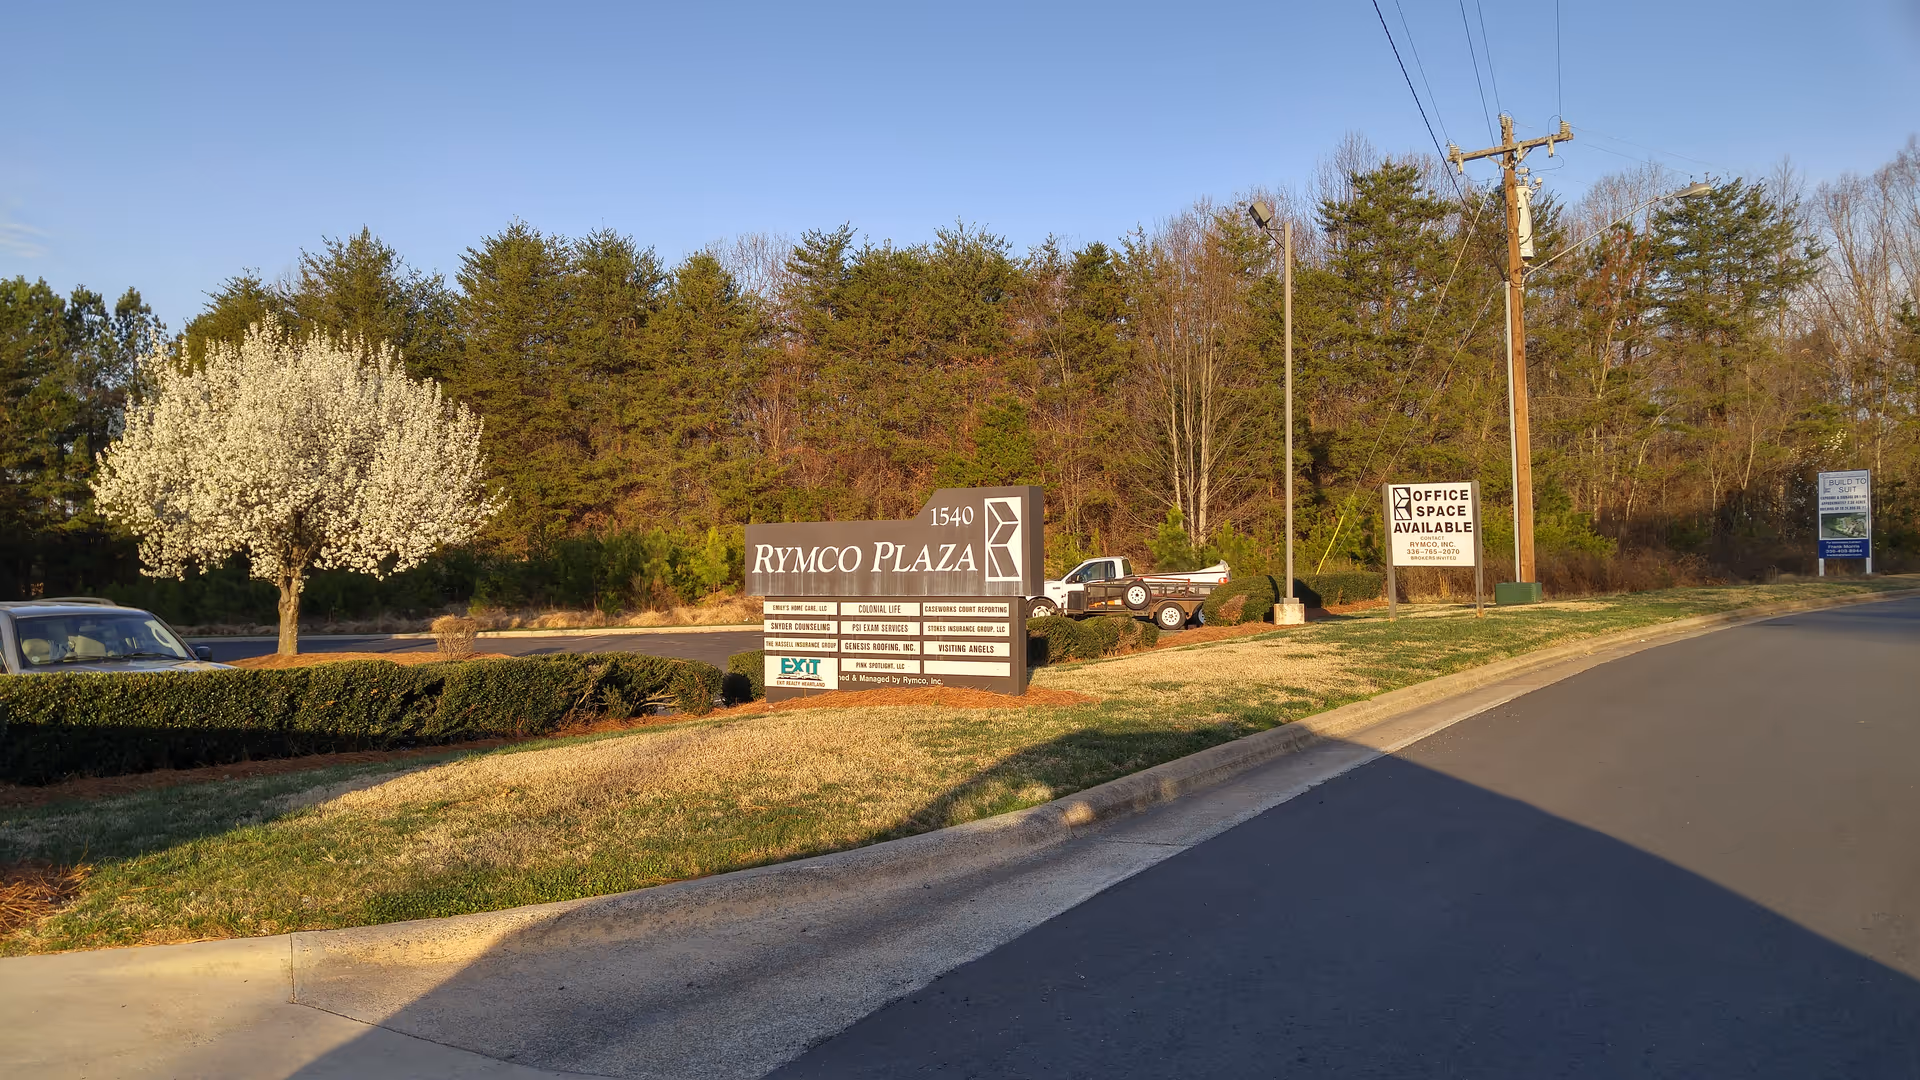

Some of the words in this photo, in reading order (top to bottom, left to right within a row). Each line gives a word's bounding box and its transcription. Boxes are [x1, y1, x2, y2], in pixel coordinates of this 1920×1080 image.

[1413, 489, 1469, 501] OFFICE
[1416, 505, 1466, 517] SPACE
[930, 506, 974, 527] 1540
[1393, 522, 1472, 533] AVAILABLE
[752, 544, 862, 573] RYMCO
[871, 542, 978, 573] PLAZA
[791, 604, 803, 612] HOME
[858, 604, 887, 614] COLONIAL
[888, 604, 902, 614] LIFE
[924, 605, 957, 613] CASEWORKS
[958, 605, 976, 613] COURT
[770, 622, 793, 631] SNYDER
[794, 622, 831, 631] COUNSELING
[852, 623, 862, 632] PSI
[863, 623, 880, 632] EXAM
[881, 624, 909, 632] SERVICES
[947, 625, 975, 633] INSURANCE
[844, 642, 871, 651] GENESIS
[872, 643, 901, 652] ROOFING,
[902, 643, 916, 652] INC.
[938, 644, 967, 653] VISITING
[968, 645, 995, 654] ANGELS
[851, 674, 857, 682] &
[859, 674, 890, 684] Managed
[892, 675, 901, 685] by
